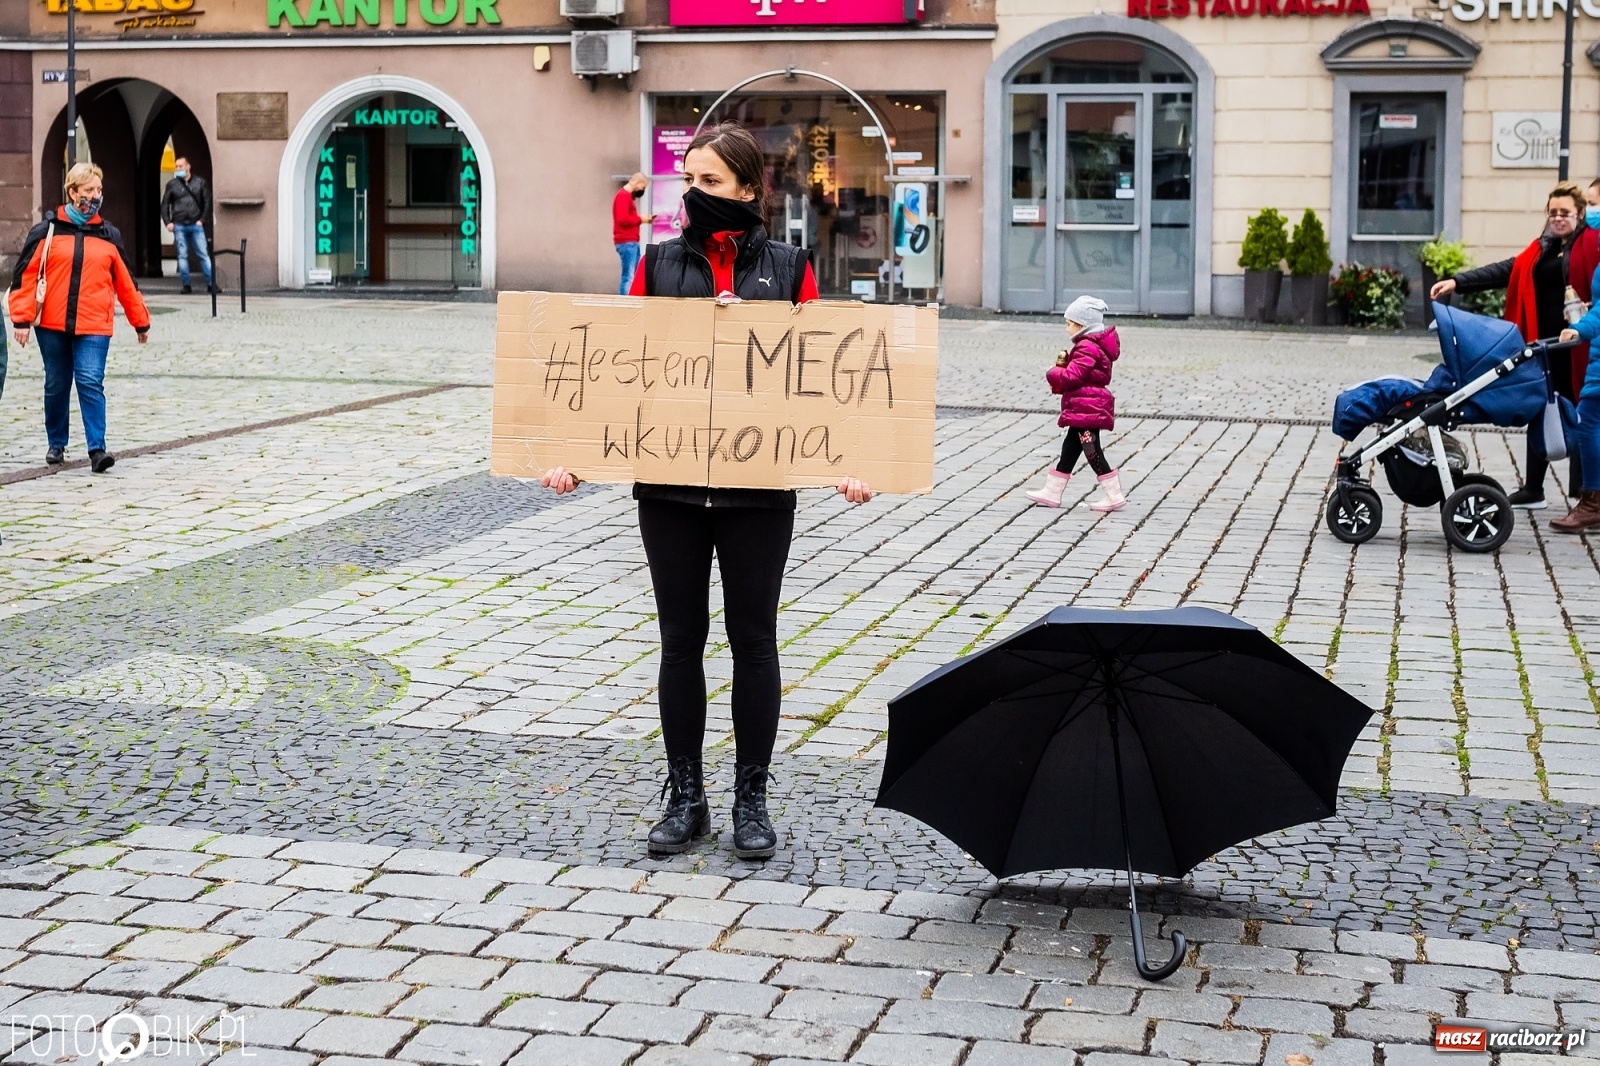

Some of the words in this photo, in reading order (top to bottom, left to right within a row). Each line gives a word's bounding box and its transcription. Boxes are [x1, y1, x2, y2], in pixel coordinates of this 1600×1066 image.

[267, 0, 501, 27] KANTOR
[1126, 0, 1371, 17] RESTAURACJA
[355, 109, 438, 125] KANTOR
[318, 147, 334, 253] KANTOR
[461, 147, 476, 254] KANTOR
[543, 322, 712, 411] #Jestem
[745, 325, 894, 409] MEGA
[603, 401, 844, 466] wkurzona
